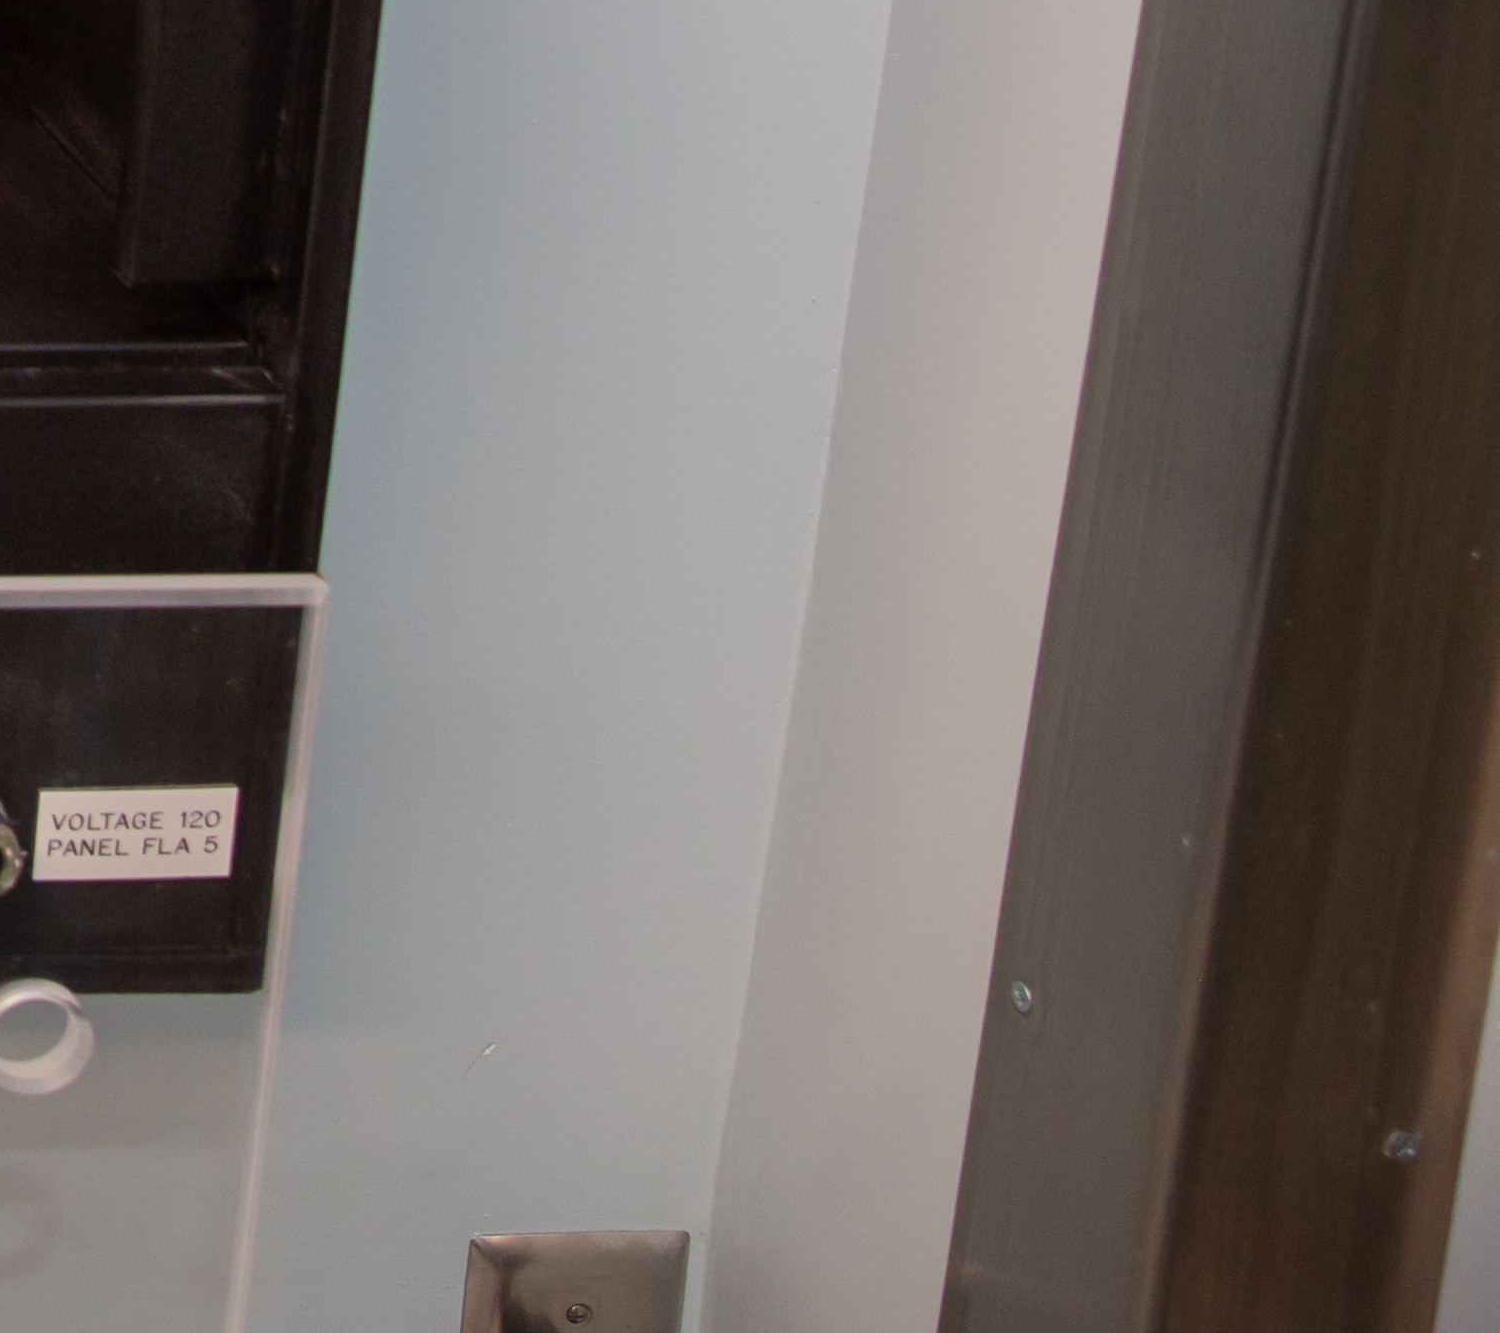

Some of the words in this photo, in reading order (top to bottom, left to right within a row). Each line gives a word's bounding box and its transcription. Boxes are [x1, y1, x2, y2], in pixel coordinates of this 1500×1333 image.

[51, 811, 164, 832] VOLTAGE
[180, 809, 222, 829] 120
[47, 838, 129, 857] PANEL
[142, 836, 191, 856] FLA
[203, 835, 219, 854] 5
